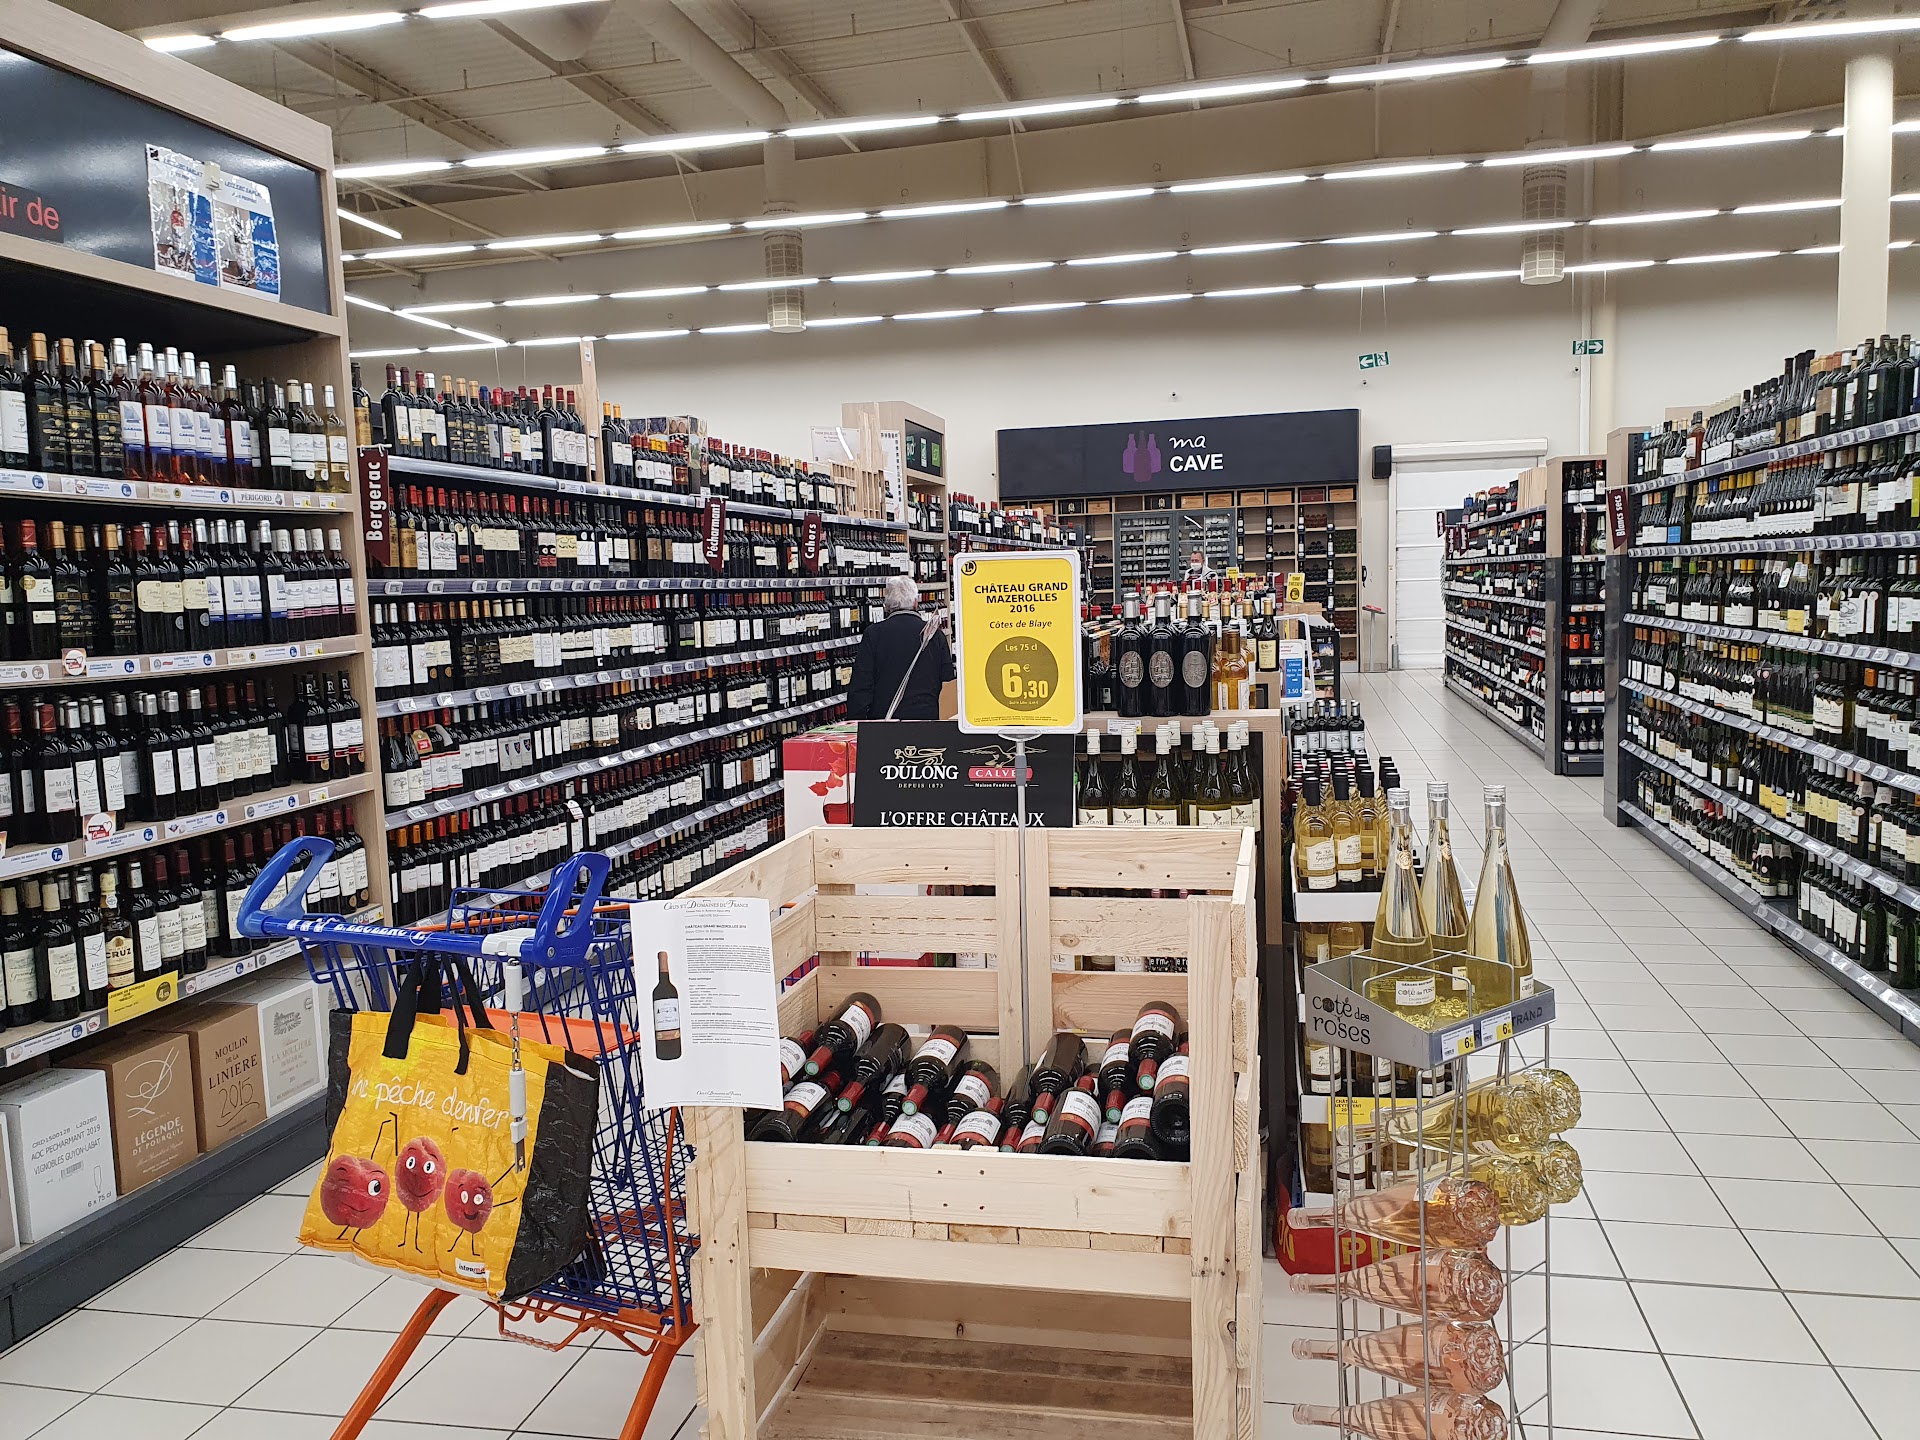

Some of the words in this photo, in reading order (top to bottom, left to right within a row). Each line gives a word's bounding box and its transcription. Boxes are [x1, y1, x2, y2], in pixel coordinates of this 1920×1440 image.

[0, 186, 19, 219] ir
[26, 196, 60, 231] de
[1168, 435, 1207, 449] ma
[1169, 453, 1224, 473] CAVE
[365, 461, 387, 541] Bergerac
[1614, 494, 1624, 512] secs
[705, 503, 721, 559] Pécharmant
[1615, 513, 1626, 538] Blancs
[804, 523, 817, 559] Cahors
[974, 583, 1025, 594] CHÂTEAU
[1028, 582, 1068, 592] GRAND
[986, 593, 1058, 604] MAZEROLLES
[1009, 604, 1036, 613] 2016
[989, 620, 1014, 629] Côtes
[1015, 620, 1027, 628] de
[1028, 620, 1053, 630] Blaye
[1005, 644, 1018, 652] Les
[1020, 643, 1030, 651] 75
[1030, 643, 1038, 651] cl
[306, 683, 314, 694] R
[326, 680, 335, 692] R
[341, 678, 349, 689] R
[880, 765, 960, 781] DULONG
[975, 768, 1016, 778] CALVE
[880, 811, 946, 827] L'OFFRE
[950, 809, 1045, 827] CHÂTEAUX
[106, 948, 132, 959] CRUZ
[1354, 1006, 1370, 1023] des
[1512, 1006, 1543, 1027] TRAND
[1312, 1016, 1371, 1045] roses
[214, 1036, 249, 1060] MOULIN
[208, 1054, 258, 1090] LINIERE
[218, 1076, 254, 1119] 2015
[374, 1076, 436, 1110] pêche
[135, 1116, 181, 1147] LÉGENDE
[31, 1148, 45, 1161] AOC
[45, 1130, 85, 1155] PECHARMANT
[86, 1123, 101, 1137] 2019
[33, 1154, 65, 1176] VIGNOBLES
[87, 1200, 92, 1208] 6
[98, 1194, 106, 1203] 75
